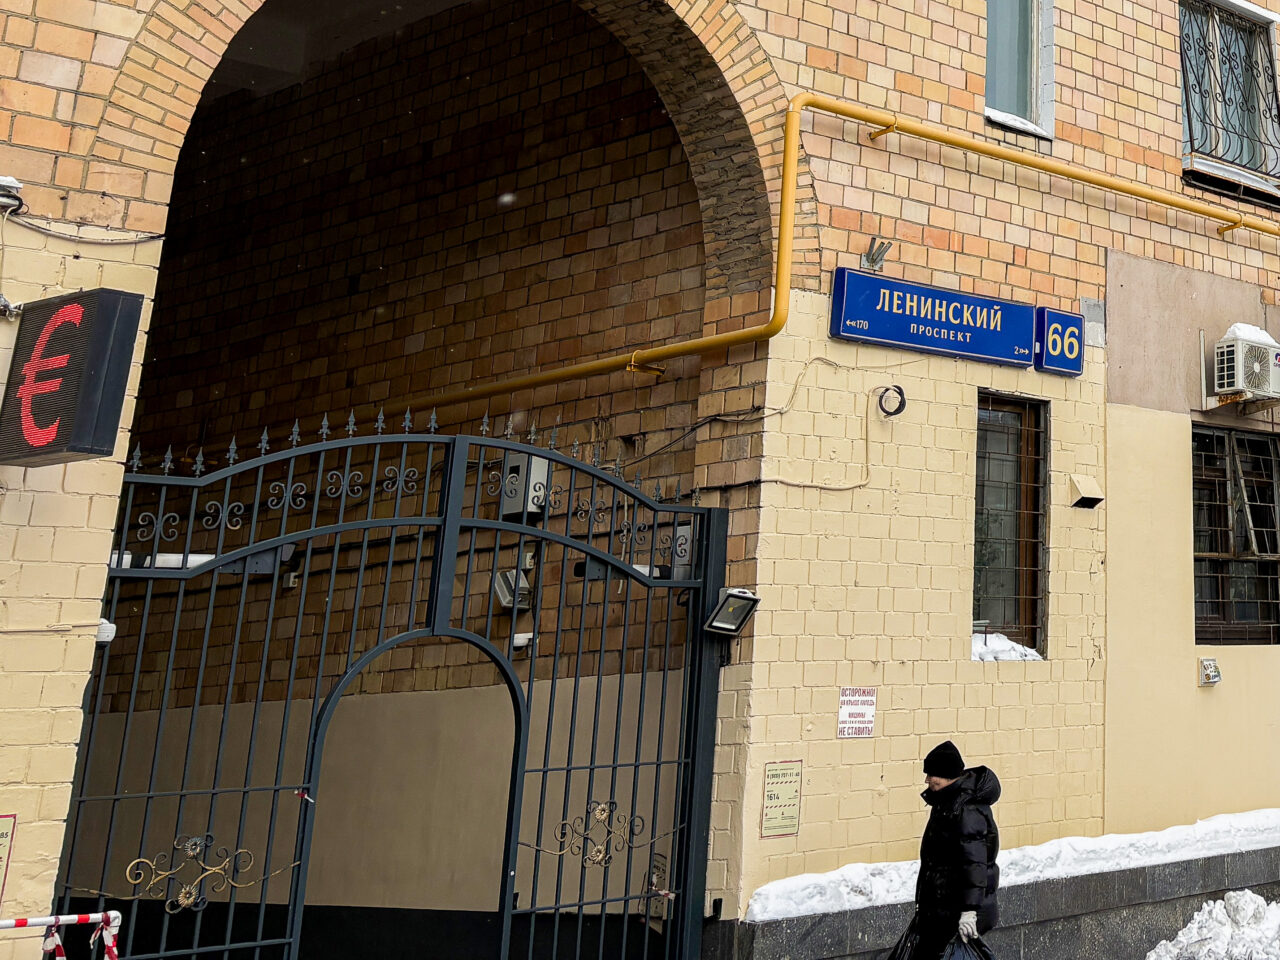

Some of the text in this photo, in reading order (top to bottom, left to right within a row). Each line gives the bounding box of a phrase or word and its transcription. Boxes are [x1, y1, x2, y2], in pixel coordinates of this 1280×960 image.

[856, 319, 869, 330] 170
[876, 288, 1003, 332] ЛЕНИНСКИЙ
[910, 323, 972, 343] ПРОСПЕКТ
[1047, 322, 1080, 360] 66
